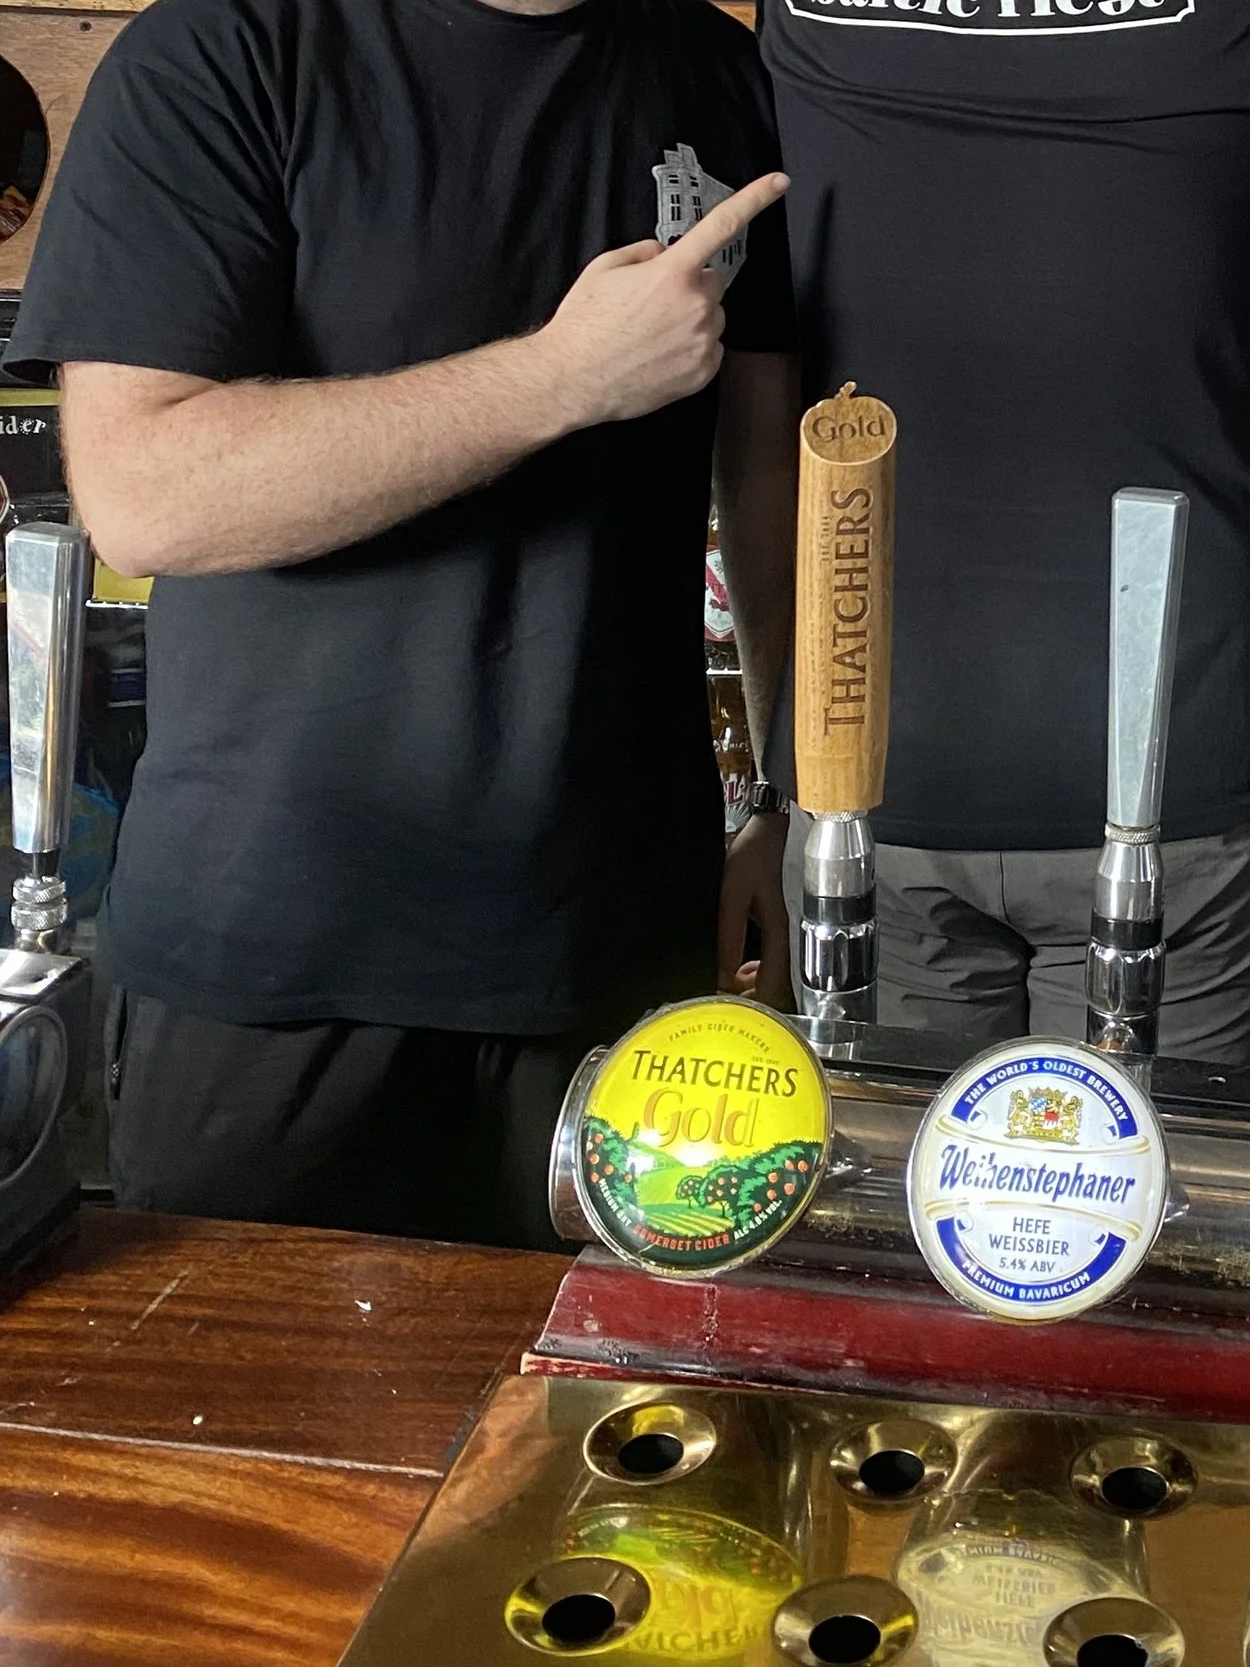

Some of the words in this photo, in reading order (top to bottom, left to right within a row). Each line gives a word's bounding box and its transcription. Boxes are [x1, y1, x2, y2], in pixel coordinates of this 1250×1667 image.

[0, 415, 47, 435] ider
[811, 413, 887, 441] Gold
[824, 487, 874, 736] THATCHERS
[631, 1049, 798, 1099] THATCHERS
[964, 1082, 988, 1105] THE
[986, 1060, 1040, 1087] WORLD'S
[1042, 1060, 1087, 1079] OLDEST
[1086, 1074, 1130, 1121] BREWERY
[643, 1087, 760, 1149] Gold
[1012, 1216, 1051, 1235] HEFE
[695, 1234, 730, 1252] CIDER
[988, 1233, 1070, 1256] WEISSBIER
[961, 1259, 1015, 1298] PREMIUM
[1018, 1272, 1092, 1300] BAVARICUM
[999, 1258, 1026, 1271] 5.4%
[1030, 1261, 1056, 1274] ABV
